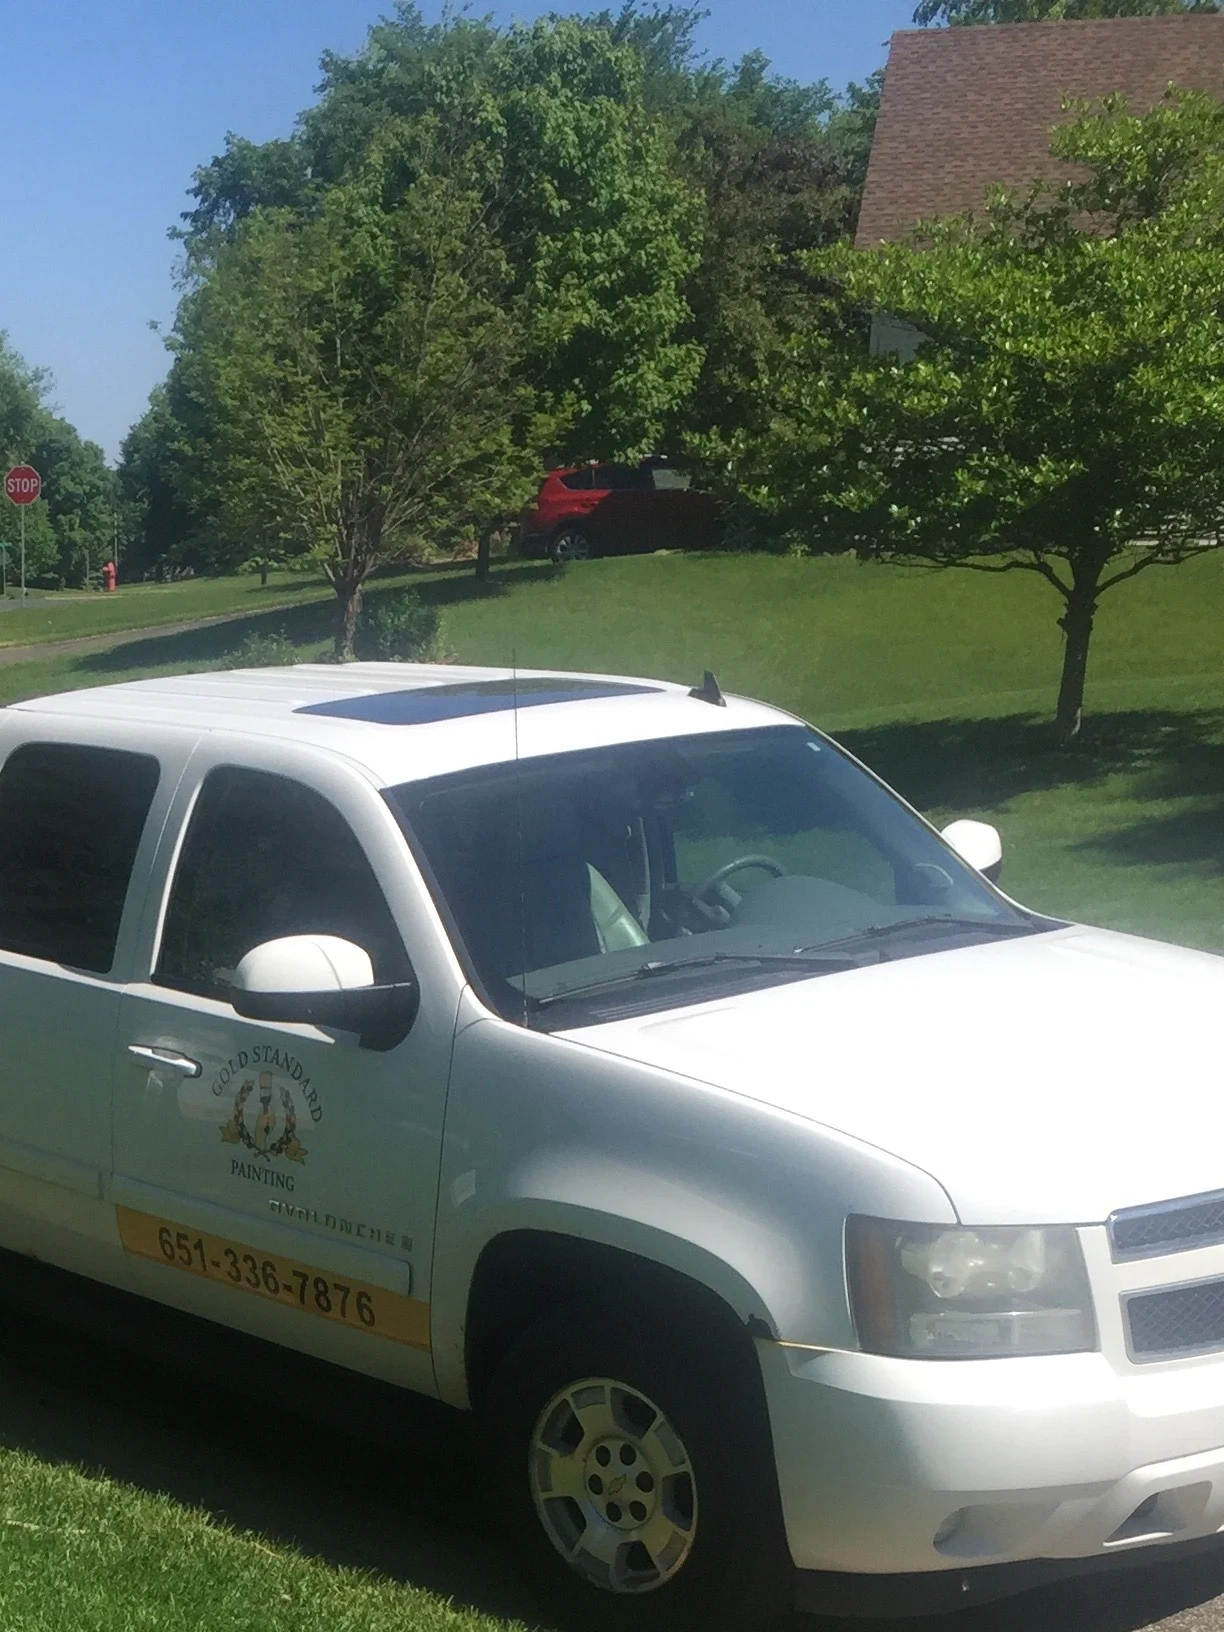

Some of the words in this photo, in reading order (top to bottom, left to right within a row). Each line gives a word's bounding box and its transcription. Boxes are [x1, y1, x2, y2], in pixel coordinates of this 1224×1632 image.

[7, 478, 38, 493] STOP
[212, 1051, 248, 1097] GOLD
[253, 1045, 323, 1123] STANDARD
[230, 1159, 295, 1192] PAINTING
[158, 1226, 376, 1327] 651-336-7876
